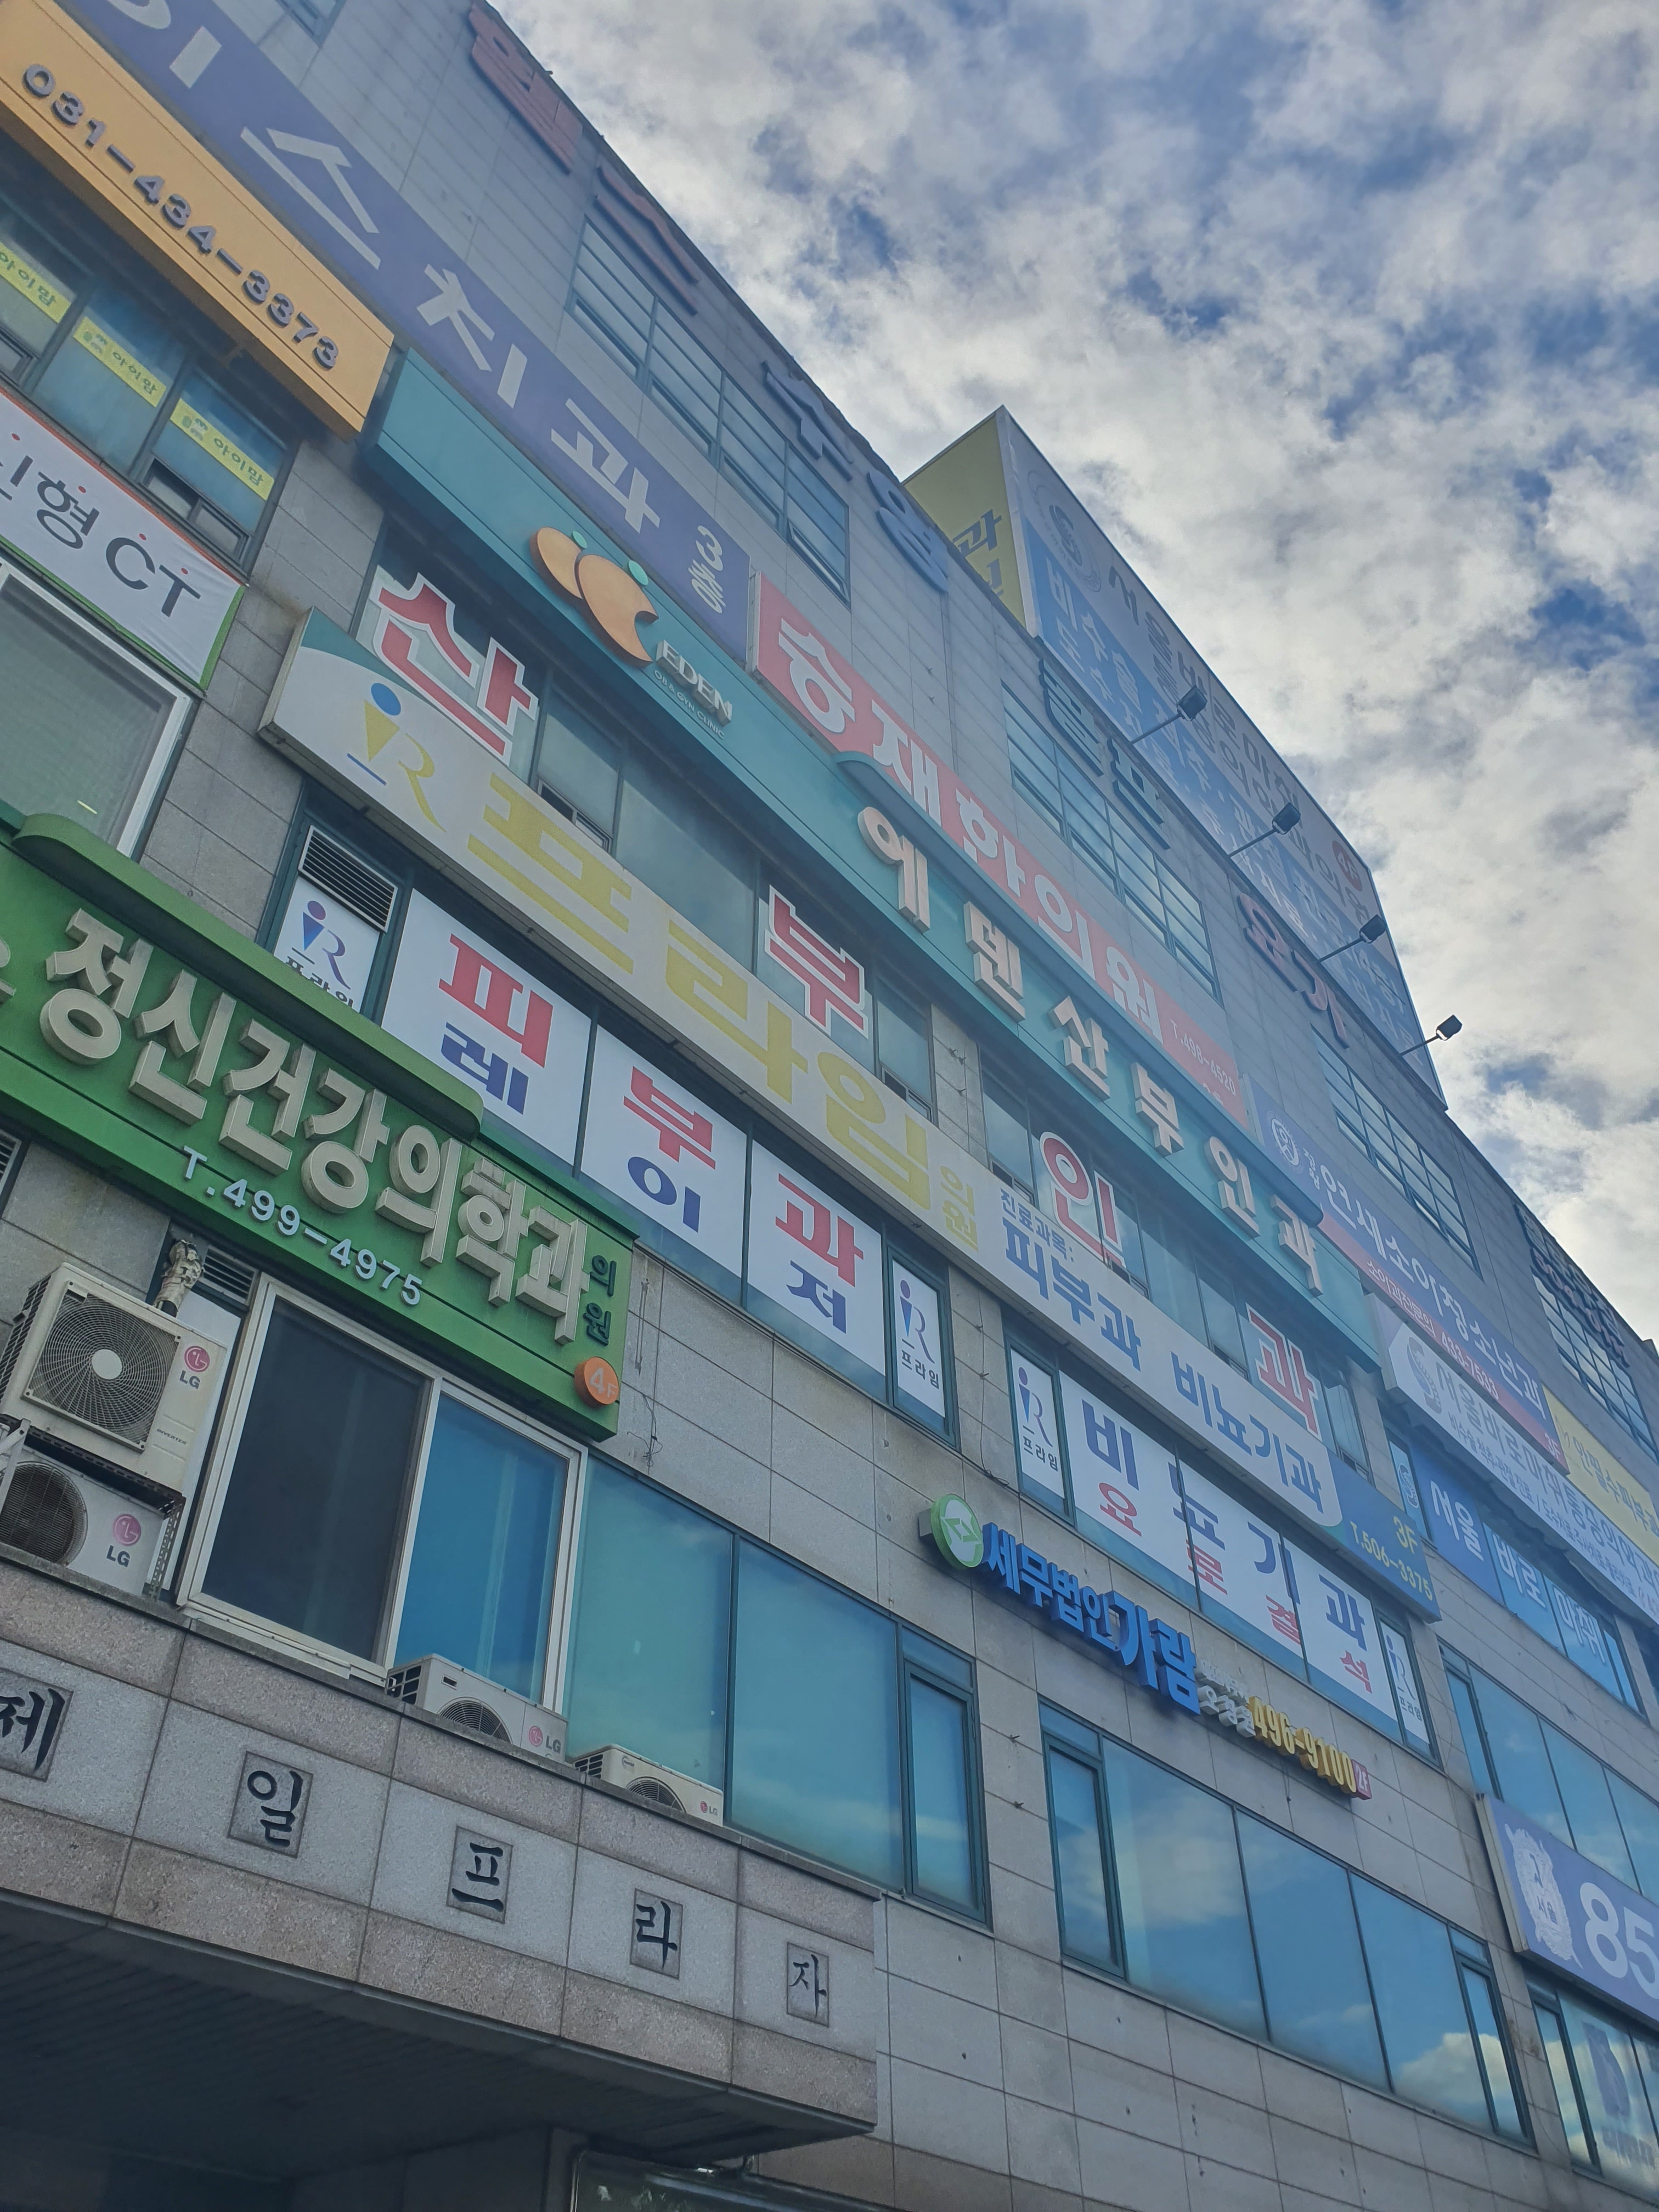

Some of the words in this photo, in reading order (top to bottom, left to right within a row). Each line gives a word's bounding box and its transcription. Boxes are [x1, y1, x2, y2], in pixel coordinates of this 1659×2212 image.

[22, 63, 341, 370] 031-434-3373
[111, 353, 158, 396] 아이맘
[213, 437, 264, 488] 아이맘
[106, 537, 201, 618] CT
[654, 670, 668, 685] OB
[677, 692, 695, 713] GYN
[697, 711, 725, 739] CLINIC
[656, 639, 732, 727] EDEN
[1039, 658, 1170, 849] 골프
[183, 1146, 422, 1307] T.499-4975
[179, 1370, 200, 1390] LG
[588, 1366, 618, 1400] 4F
[901, 1350, 939, 1390] 프라임
[1002, 1217, 1142, 1372] 피부과
[1170, 1351, 1324, 1514] 비뇨기과
[1441, 1333, 1499, 1400] 433-7533
[1023, 1436, 1058, 1472] 프라임
[106, 1545, 131, 1568] LG
[1350, 1521, 1433, 1601] T.506-3375
[1393, 1516, 1418, 1554] 3F
[1430, 1481, 1485, 1561] 서울
[1492, 1534, 1547, 1609] 바로
[545, 1734, 561, 1754] LG
[1248, 1696, 1357, 1794] 496-9100
